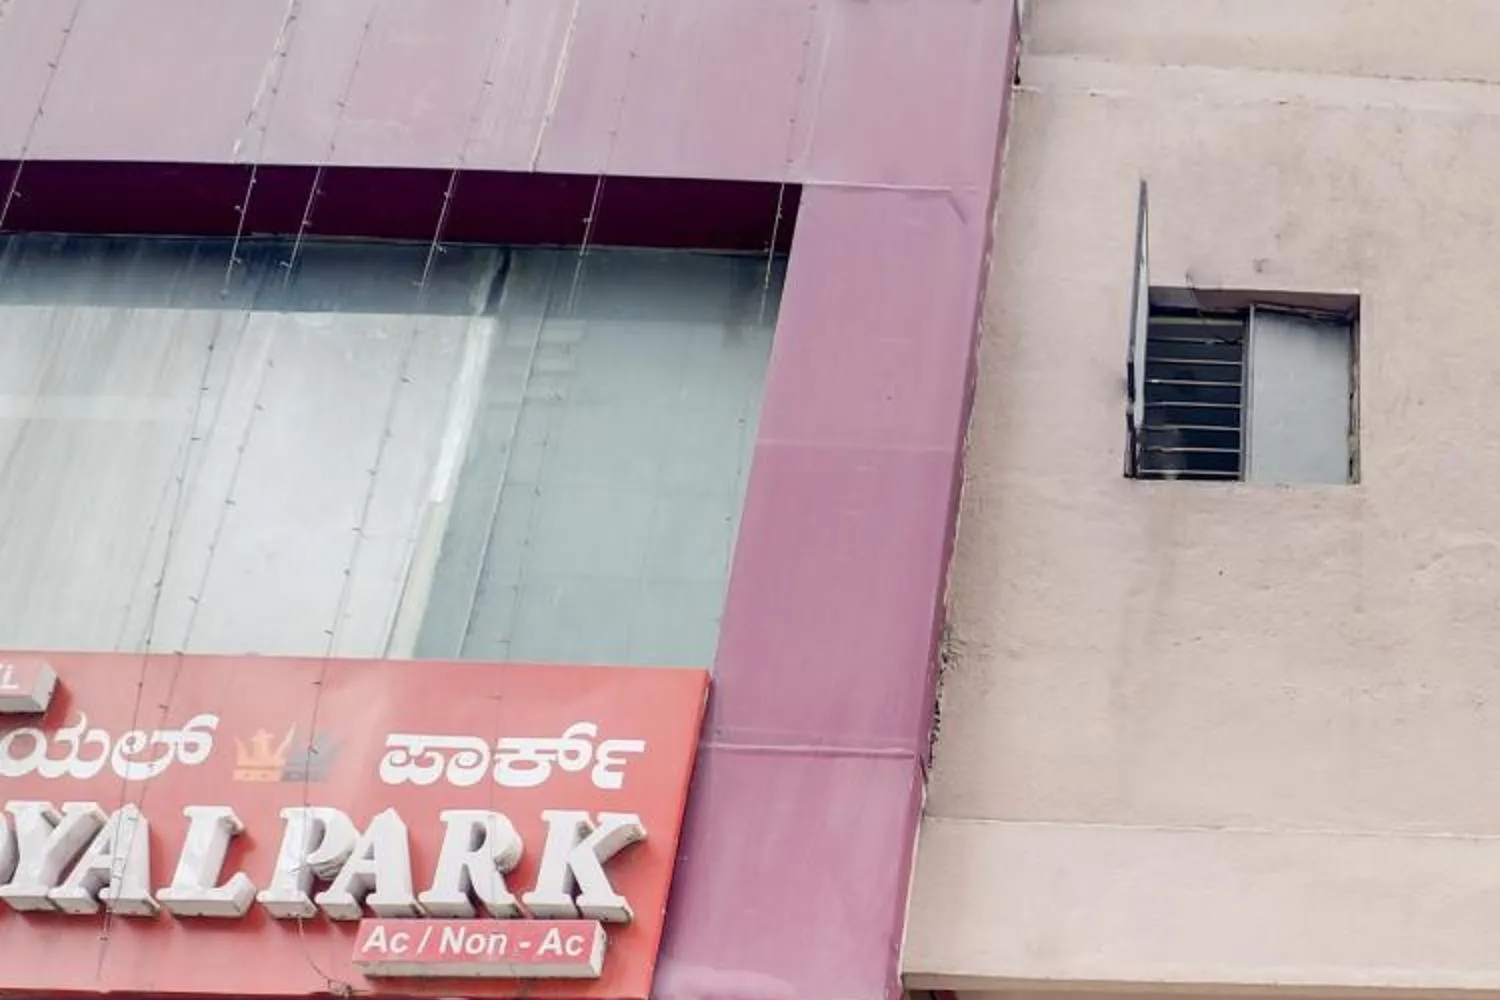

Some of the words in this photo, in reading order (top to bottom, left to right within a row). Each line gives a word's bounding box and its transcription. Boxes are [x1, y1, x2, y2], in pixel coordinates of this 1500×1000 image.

[0, 663, 19, 690] L
[257, 806, 647, 923] PARK
[362, 925, 410, 953] Ac
[438, 926, 508, 955] Non
[537, 927, 585, 957] Ac
